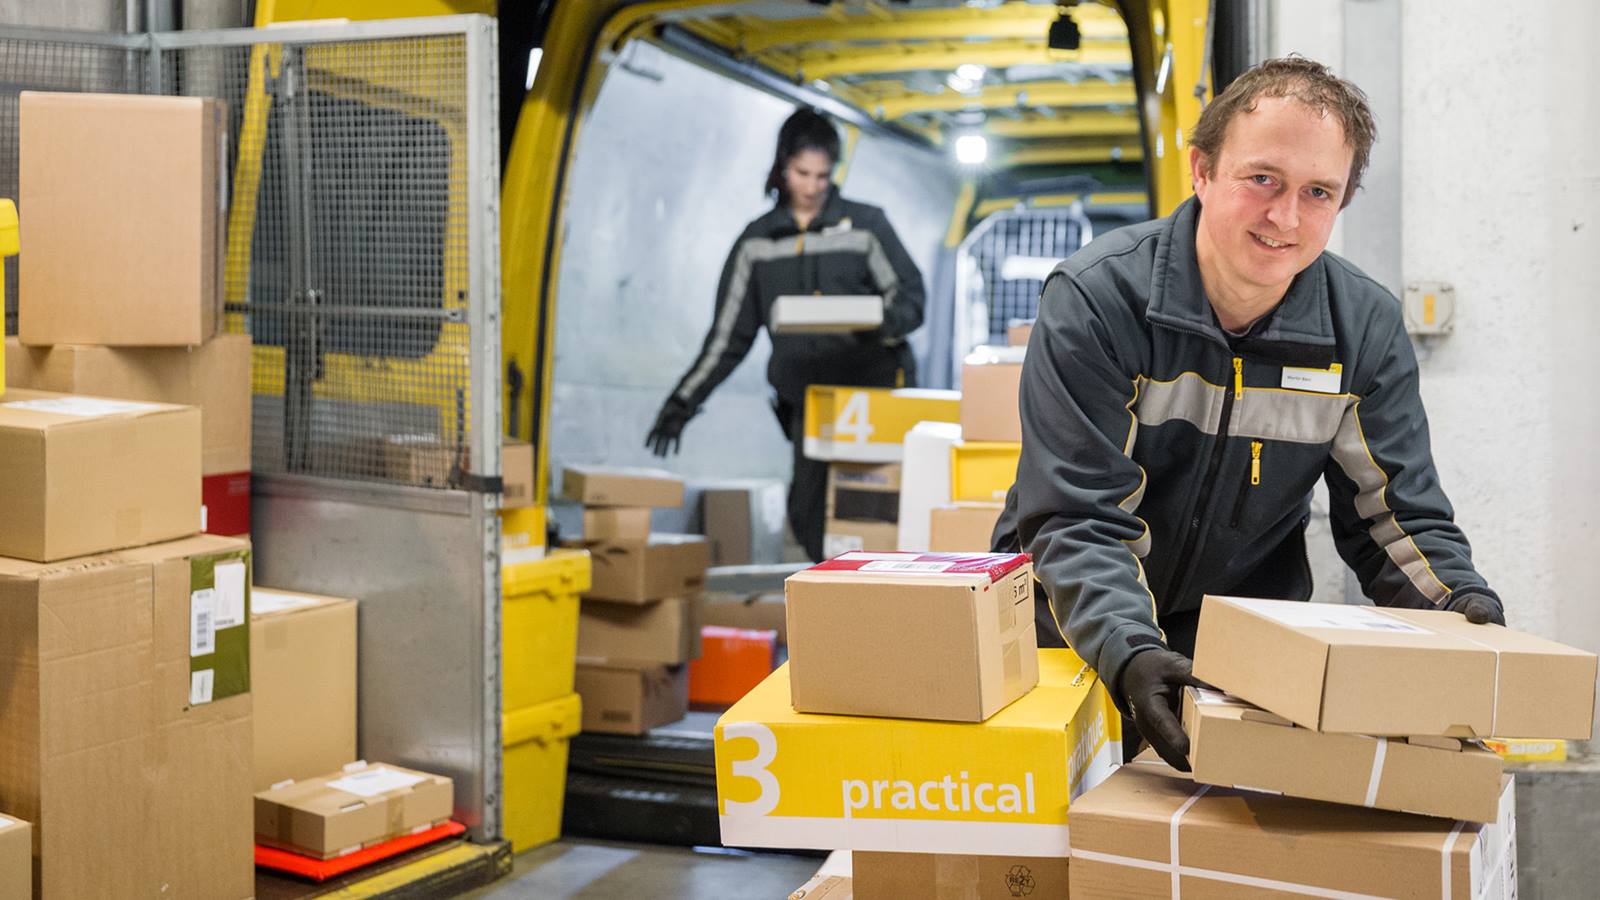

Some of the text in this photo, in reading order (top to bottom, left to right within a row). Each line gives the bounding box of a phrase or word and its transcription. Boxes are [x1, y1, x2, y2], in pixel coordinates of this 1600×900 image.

[835, 391, 874, 443] 4
[723, 721, 780, 817] 3
[1067, 709, 1104, 785] pratique
[841, 770, 1035, 821] practical
